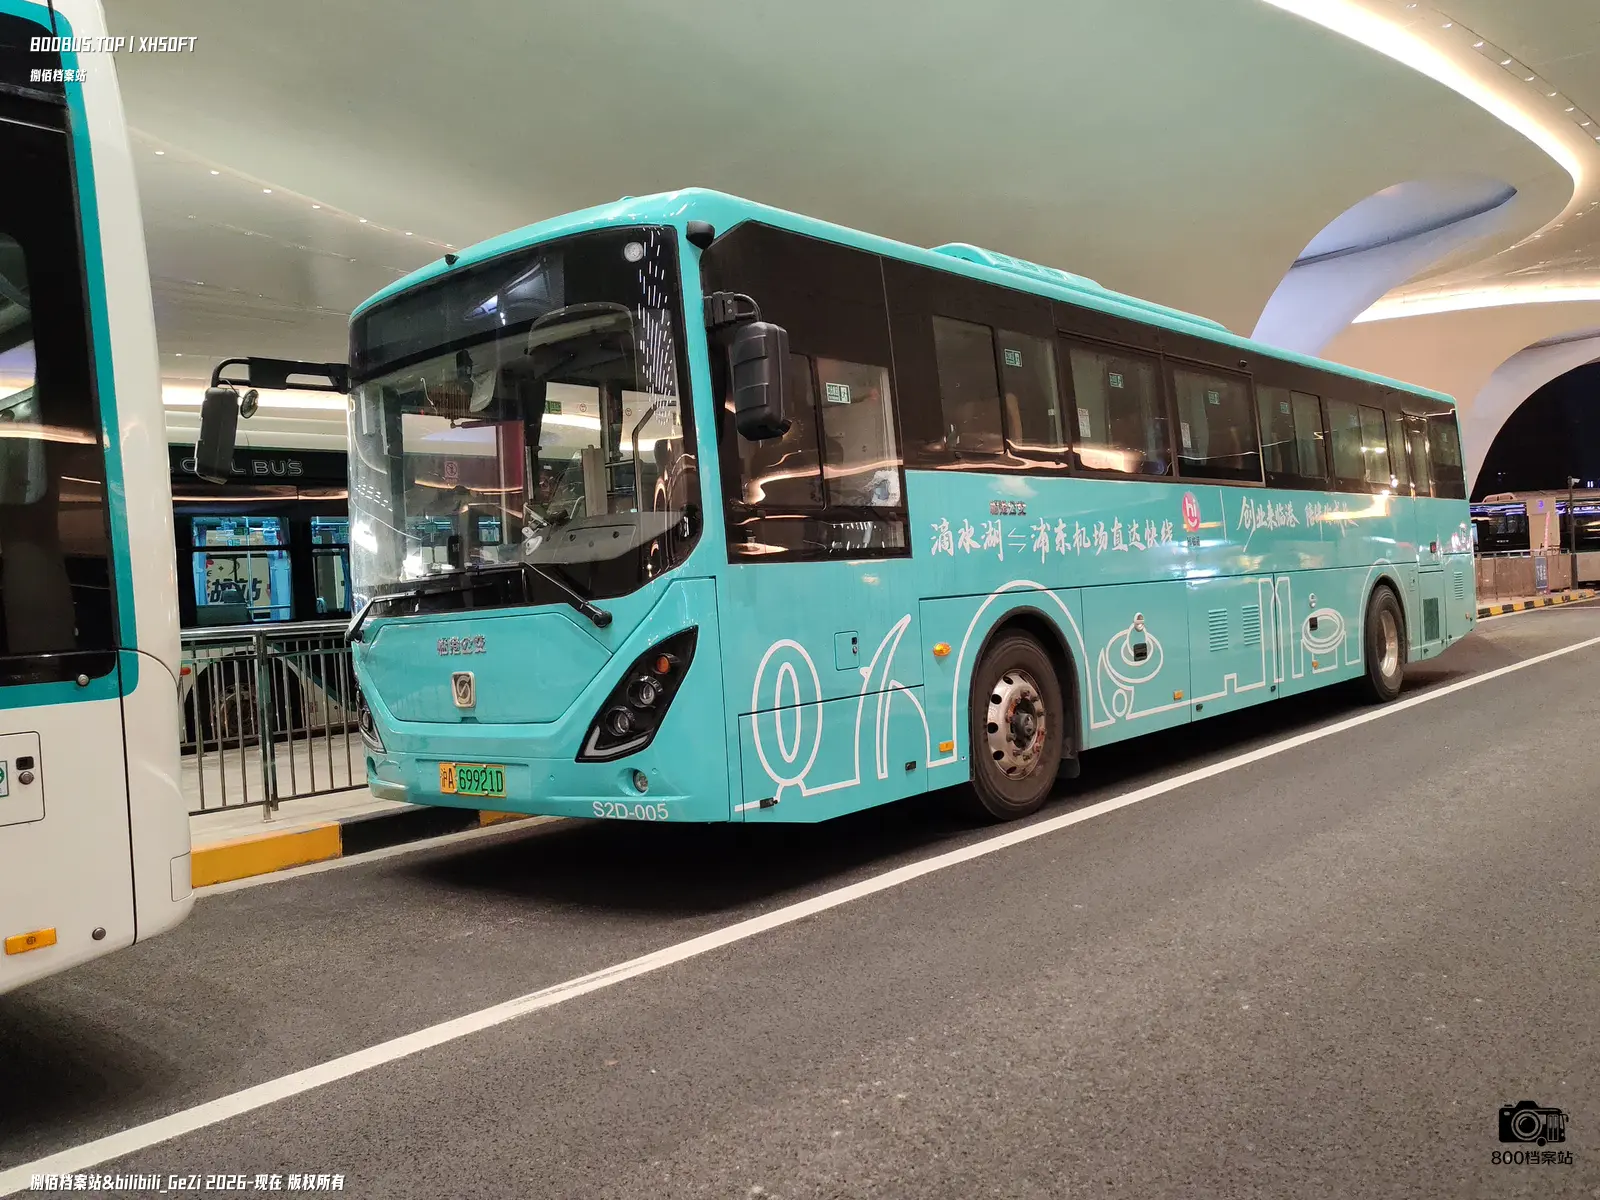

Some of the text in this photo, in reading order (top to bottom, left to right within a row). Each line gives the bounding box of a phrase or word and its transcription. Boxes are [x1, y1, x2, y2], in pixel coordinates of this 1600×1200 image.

[253, 459, 303, 476] BUS
[930, 516, 1177, 564] 滴水湖 浦东机场直达快线
[592, 801, 669, 820] S2D-005
